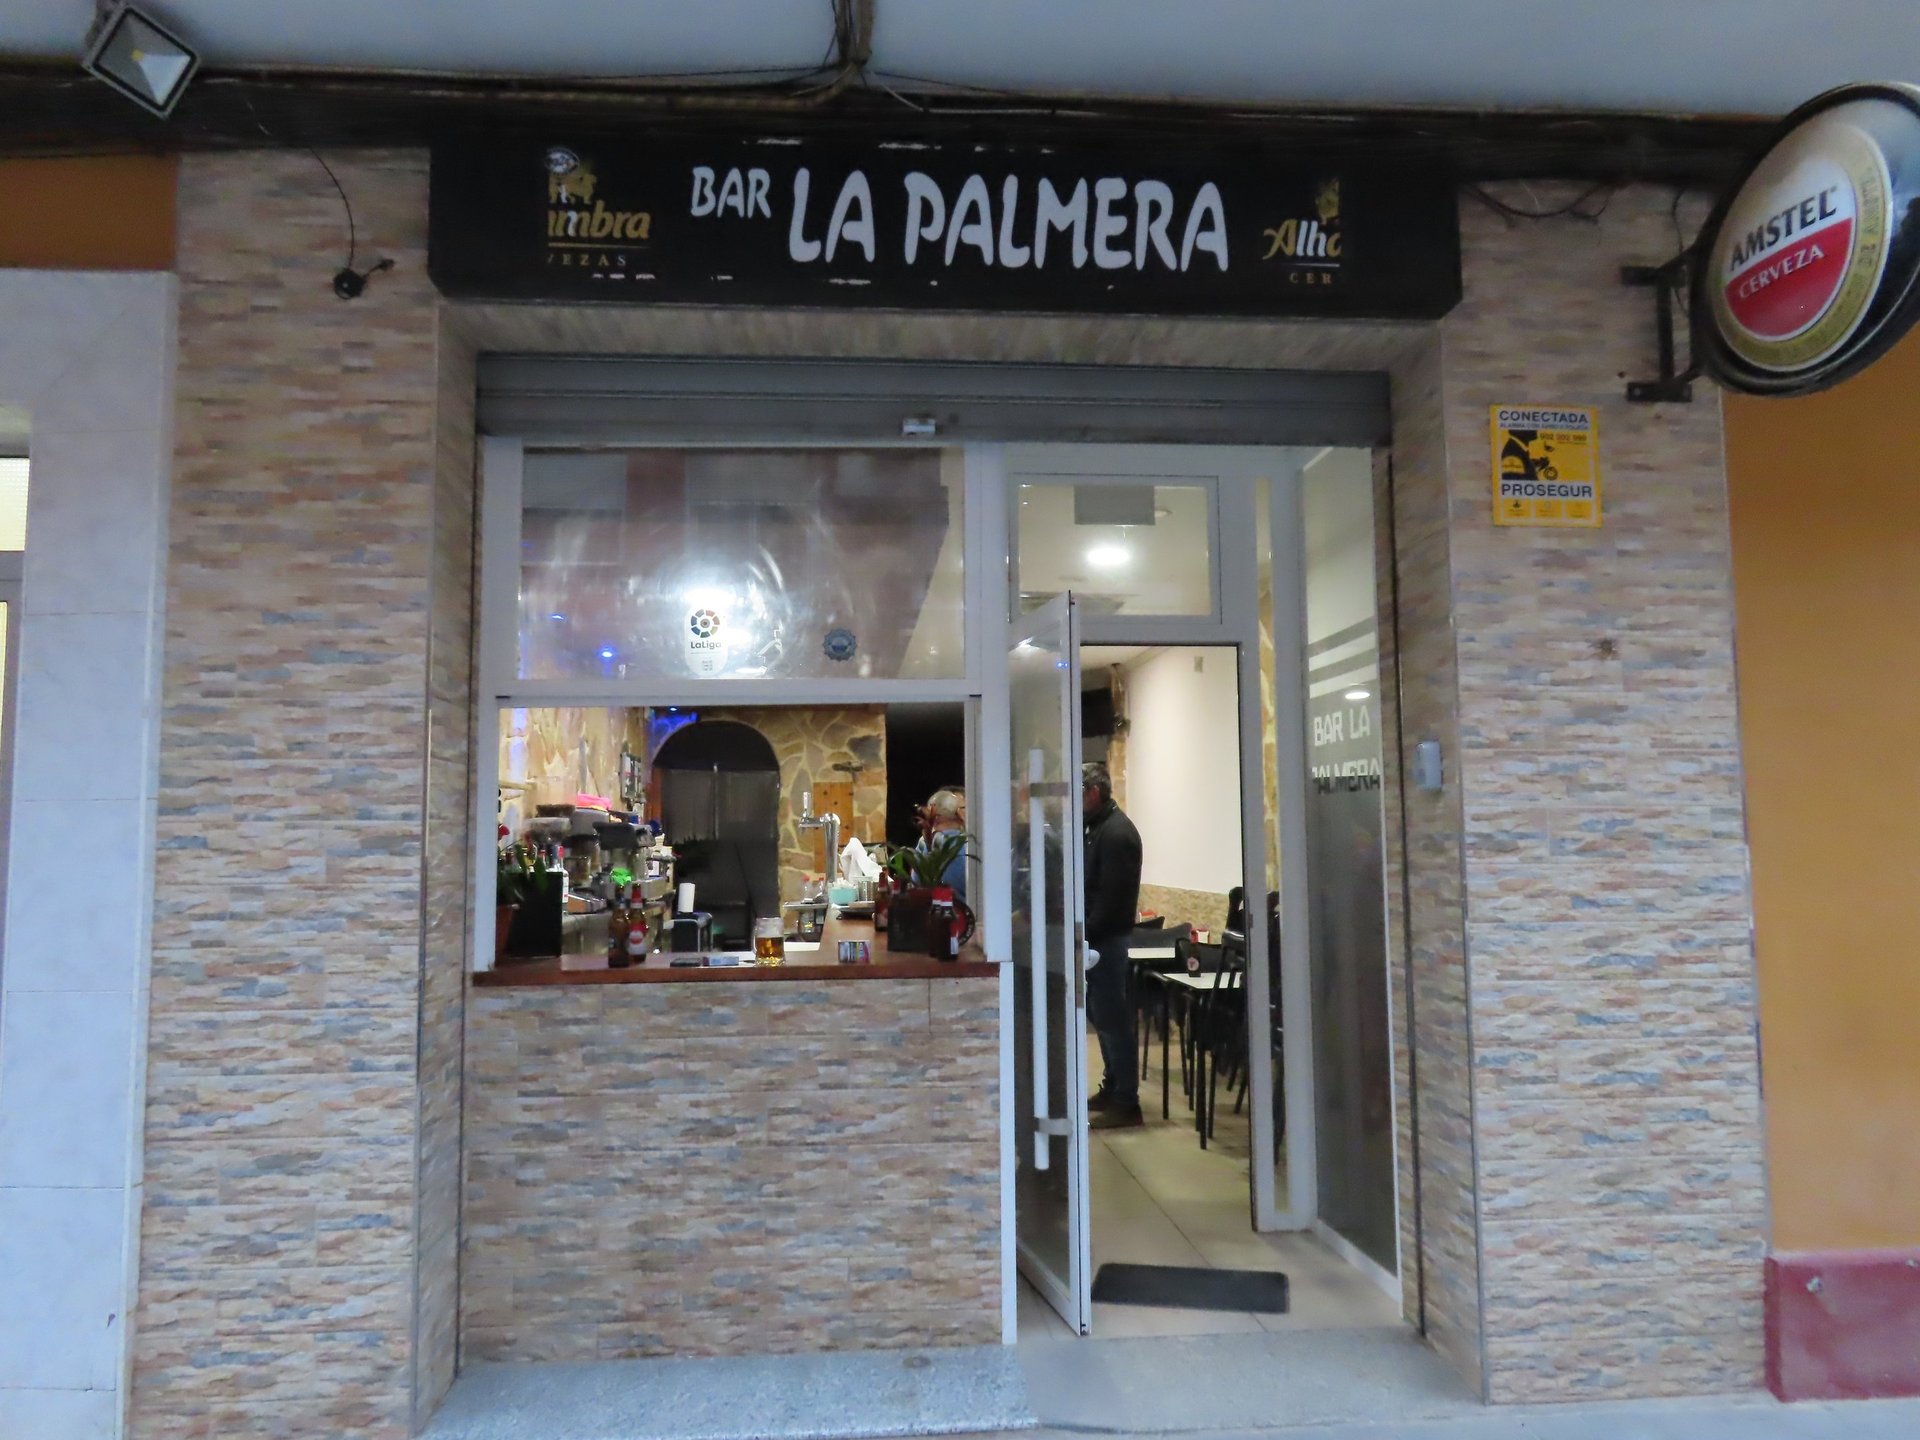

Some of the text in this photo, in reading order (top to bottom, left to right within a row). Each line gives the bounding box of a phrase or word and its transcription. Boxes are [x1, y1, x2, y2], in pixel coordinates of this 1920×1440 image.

[690, 166, 1229, 273] BAR LA PALMERA
[1730, 189, 1837, 271] AMSTEL
[1738, 243, 1825, 300] CERVEZA
[1499, 410, 1589, 423] CONECTADA
[1501, 483, 1592, 497] PROSEGUR
[690, 640, 722, 650] LaLiga
[1313, 704, 1371, 747] BAR LA
